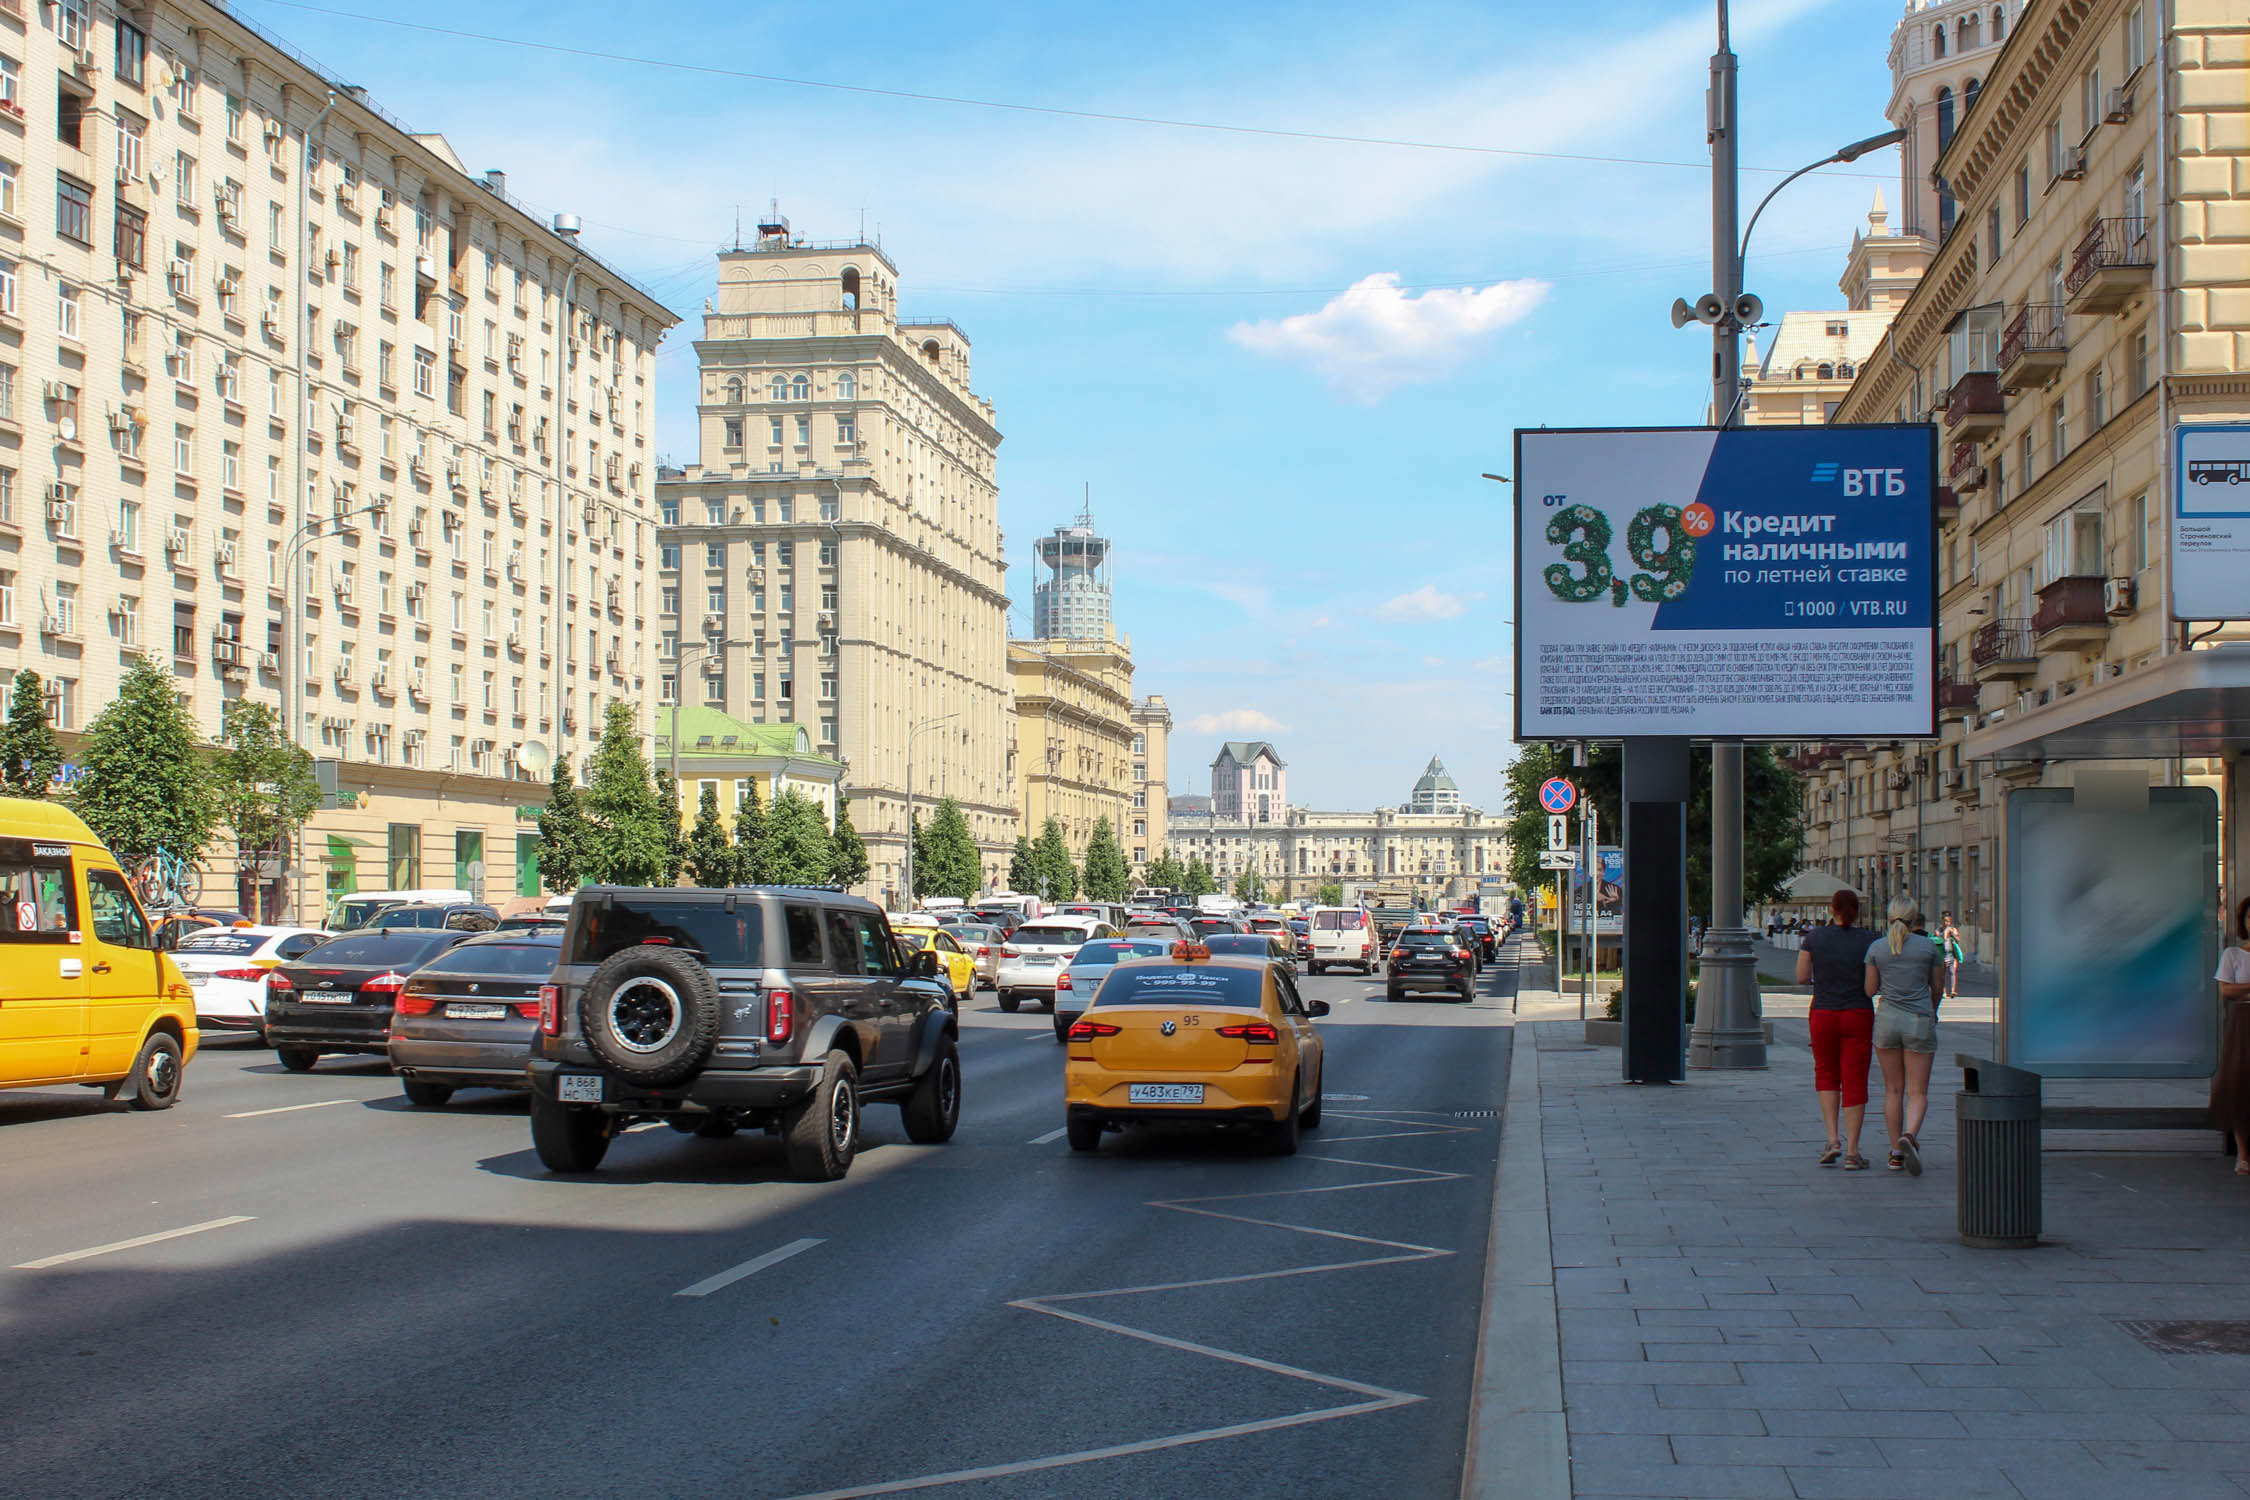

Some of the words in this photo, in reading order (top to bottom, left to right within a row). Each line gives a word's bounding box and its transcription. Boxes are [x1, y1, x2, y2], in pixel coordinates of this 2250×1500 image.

[1843, 468, 1906, 497] ВТБ
[1723, 511, 1836, 538] Кредит
[1723, 541, 1907, 561] наличными
[1724, 570, 1751, 584] по
[1756, 564, 1831, 583] летней
[1837, 568, 1907, 583] ставке
[1797, 601, 1835, 616] 1000
[1850, 600, 1907, 616] VTB.RU
[34, 845, 72, 857] ЗАКАЗНОЙ
[1198, 974, 1230, 982] Такси
[1183, 1015, 1200, 1026] 95
[566, 1077, 574, 1087] А
[577, 1077, 596, 1088] 868
